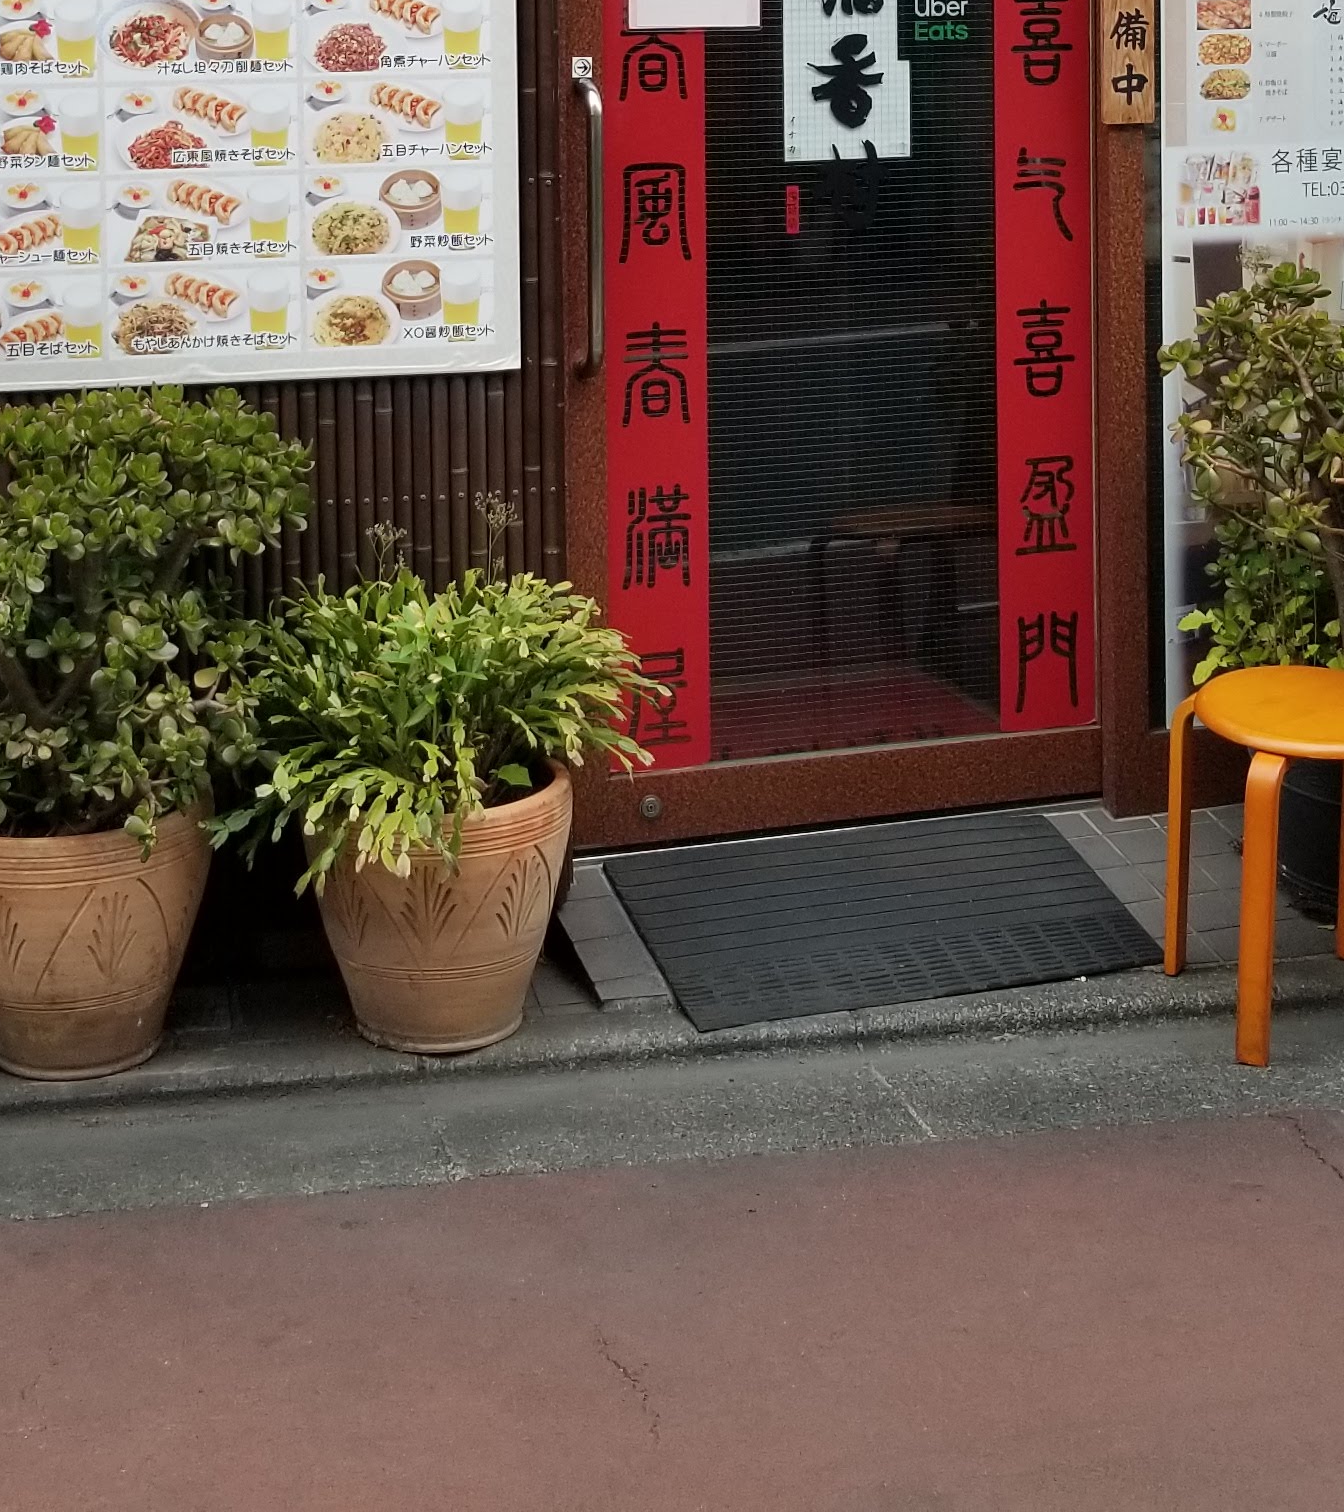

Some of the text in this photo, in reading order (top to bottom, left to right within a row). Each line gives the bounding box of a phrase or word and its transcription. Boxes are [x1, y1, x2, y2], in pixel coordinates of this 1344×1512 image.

[914, 20, 969, 41] Eats
[380, 54, 492, 68] 角煮チャーハンセット
[0, 62, 89, 76] 鶏肉そばセット
[172, 148, 296, 163] 広東風焼きそばセット
[382, 142, 493, 157] 五目チャーハンセット
[188, 240, 297, 256] 五目焼きそばセット
[410, 234, 494, 248] 野菜炒飯セット
[133, 333, 298, 351] もやしあんかけ焼きそばセット
[6, 342, 98, 358] 五目そばセット
